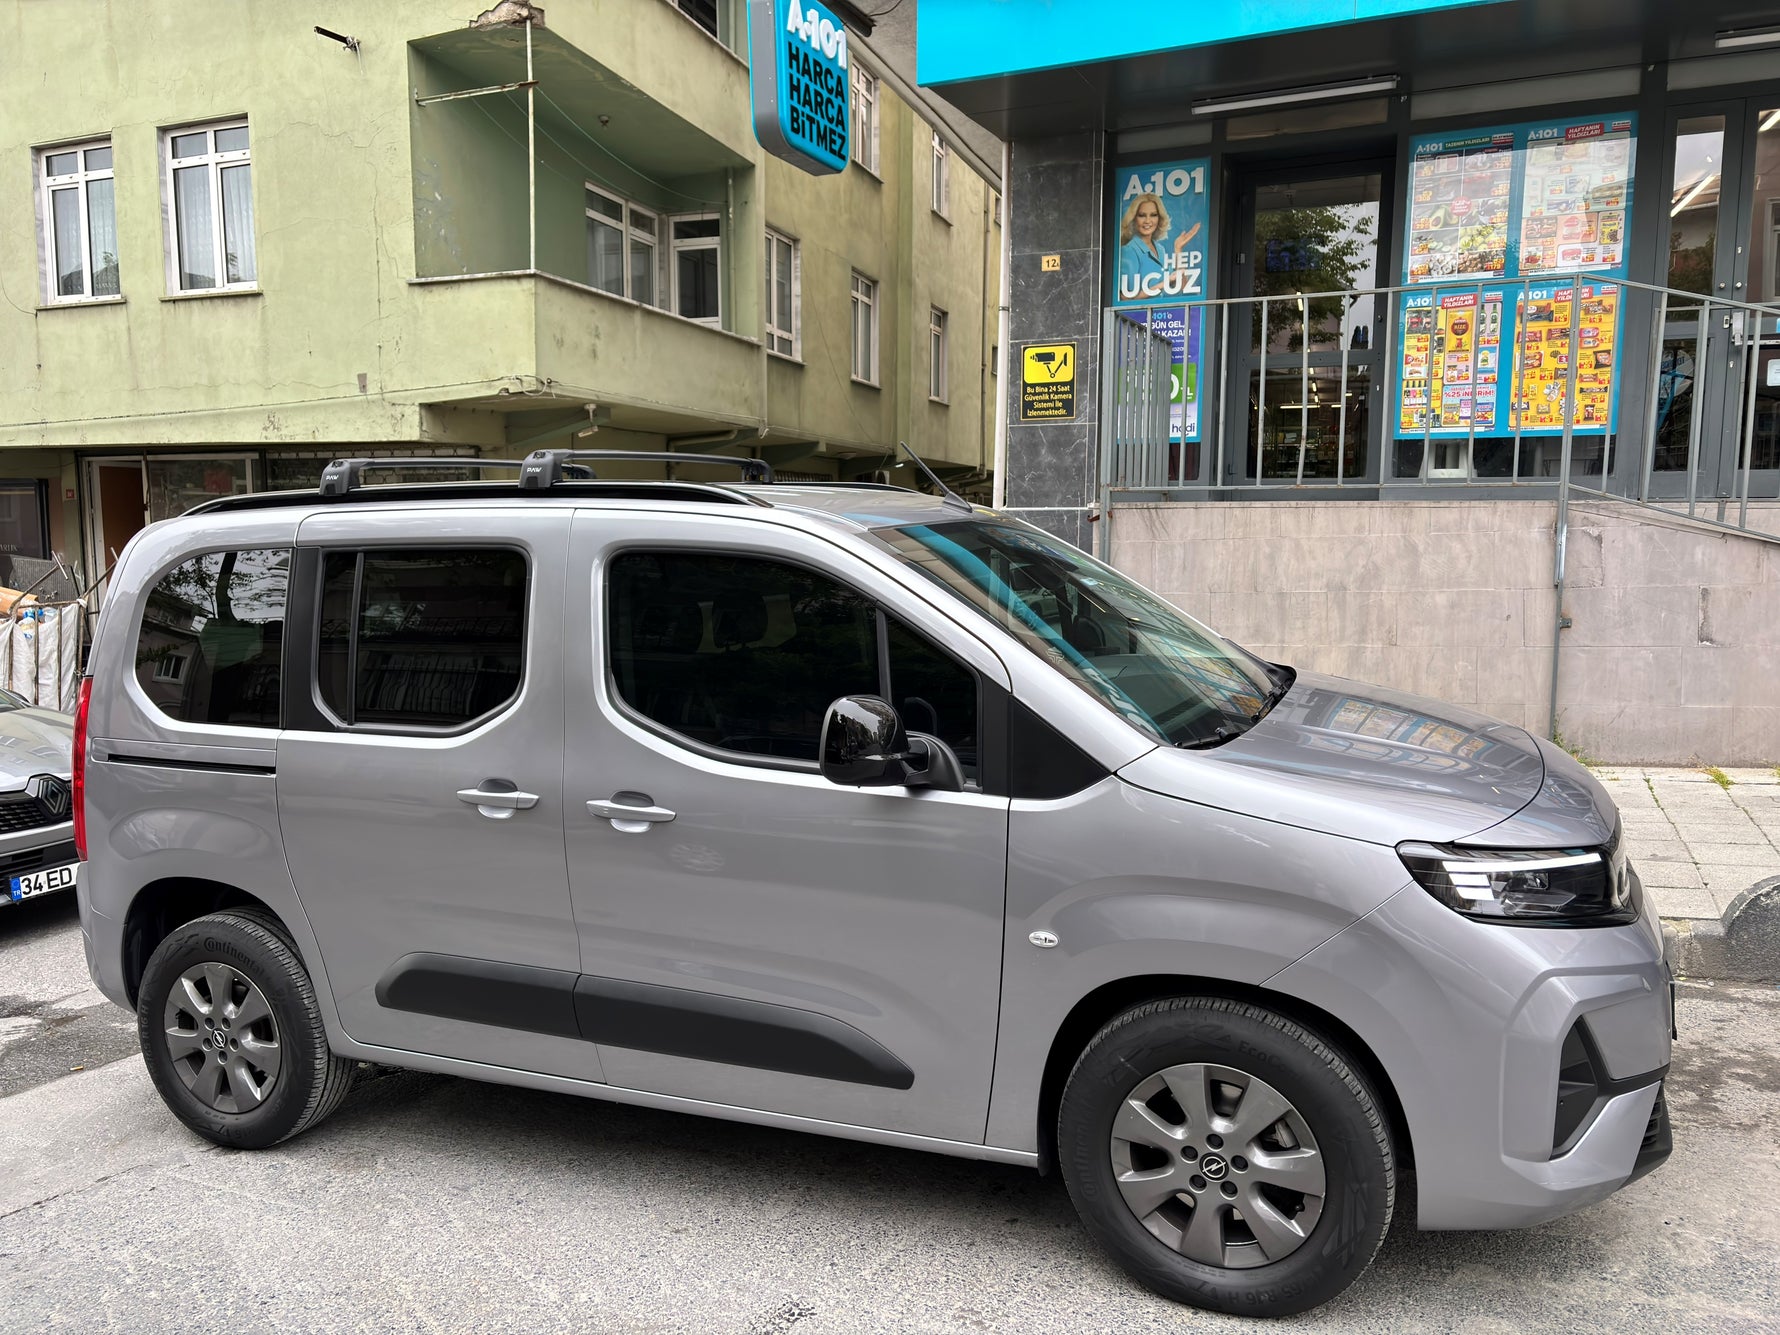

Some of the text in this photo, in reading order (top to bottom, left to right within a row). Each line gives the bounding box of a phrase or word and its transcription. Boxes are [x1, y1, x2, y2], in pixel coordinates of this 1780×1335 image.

[788, 41, 846, 103] HARCA
[789, 74, 846, 132] HARCA
[1164, 250, 1202, 272] HEP
[1121, 268, 1202, 298] UCUZ
[1161, 328, 1192, 338] KAZA!
[1024, 392, 1072, 401] Güvenlik Kamera
[1035, 385, 1048, 393] Bina
[1057, 384, 1070, 392] Saat
[1033, 401, 1054, 409] Sistemi
[21, 867, 73, 896] 34 ED
[203, 936, 265, 977] Continental
